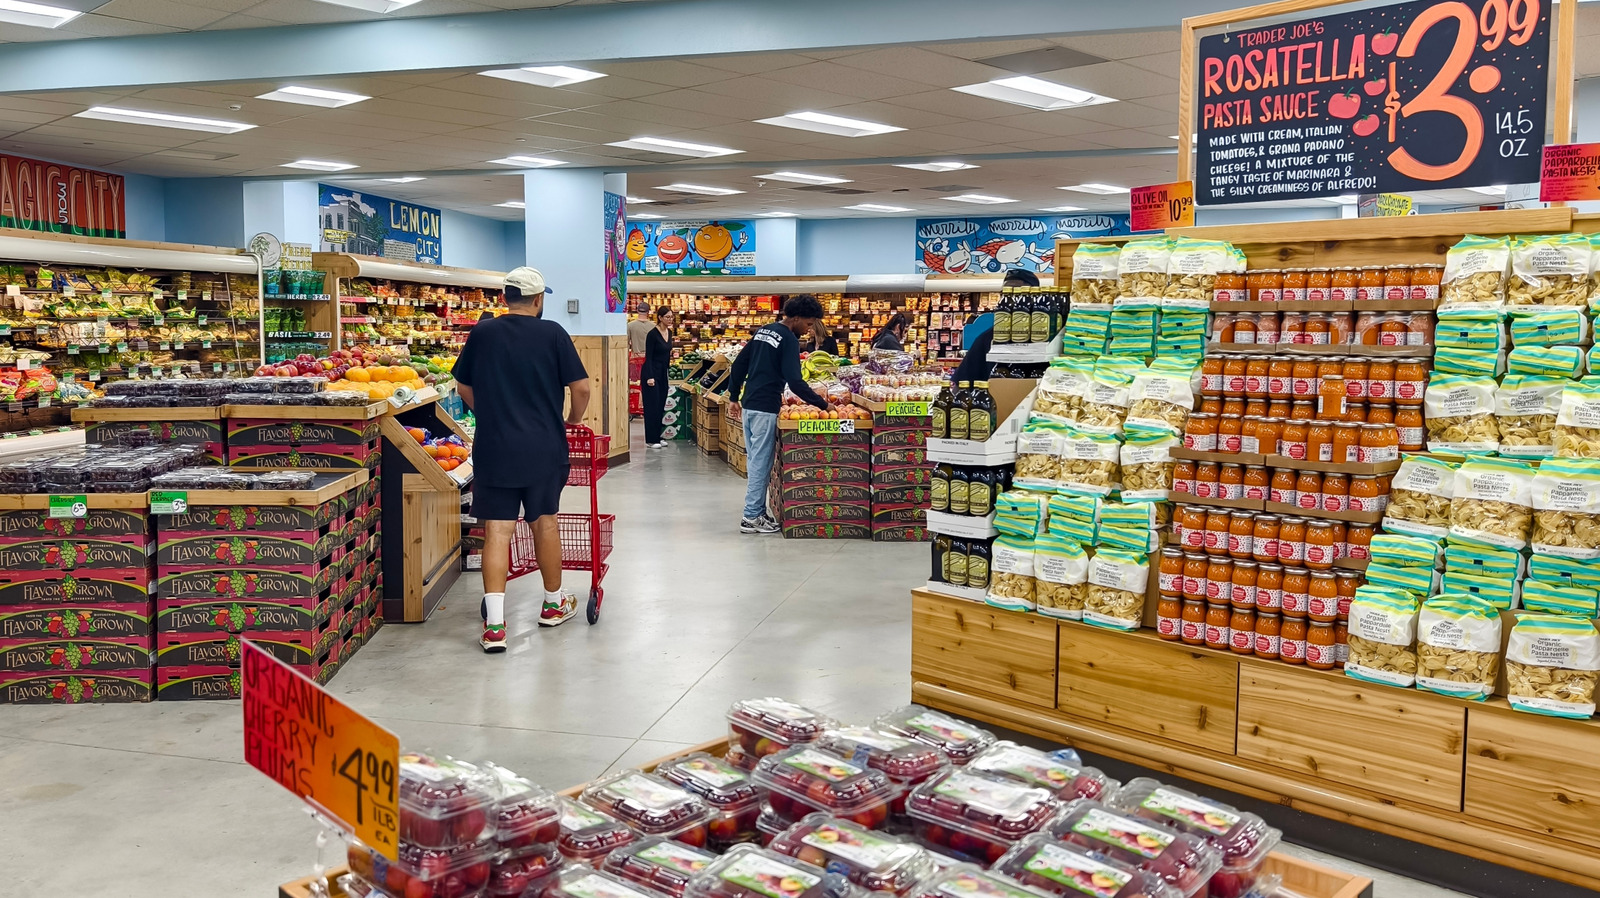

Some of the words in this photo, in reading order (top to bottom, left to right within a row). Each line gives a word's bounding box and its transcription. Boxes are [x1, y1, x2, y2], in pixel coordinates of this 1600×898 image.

[1237, 27, 1286, 49] TRADER
[1290, 22, 1325, 40] JOE'S
[1204, 33, 1366, 98] ROSATELLA
[1203, 99, 1252, 130] PASTA
[1259, 90, 1320, 123] SAUCE
[1495, 109, 1534, 135] 14.5
[1209, 134, 1237, 148] MADE
[1240, 131, 1265, 144] WITH
[1268, 128, 1304, 140] CREAM,
[1305, 125, 1343, 137] ITALIAN
[1268, 143, 1301, 155] GRANA
[1304, 139, 1345, 152] PADANO
[1499, 138, 1529, 158] OZ
[1545, 148, 1581, 158] ORGANIC
[1210, 162, 1250, 175] CHEESE!
[1255, 160, 1262, 170] A
[1266, 155, 1314, 170] MIXTURE
[1317, 153, 1331, 164] OF
[1335, 152, 1355, 163] THE
[1543, 168, 1568, 178] PASTA
[1570, 166, 1596, 176] NESTS
[1210, 174, 1240, 186] TANGY
[1242, 171, 1270, 183] TASTE
[1273, 171, 1284, 181] OF
[1286, 168, 1340, 181] MARINARA
[1344, 165, 1352, 177] &
[1210, 187, 1225, 198] THE
[1229, 184, 1255, 197] SILKY
[1257, 182, 1309, 195] CREAMINESS
[1311, 181, 1324, 191] OF
[1327, 175, 1377, 191] ALFREDO!
[57, 182, 68, 224] 305
[69, 168, 121, 239] CITY
[1131, 191, 1157, 205] OLIVE
[1157, 190, 1169, 203] OIL
[389, 202, 440, 239] LEMON
[919, 218, 980, 248] merrily
[989, 219, 1045, 241] merrily
[1056, 215, 1120, 236] merrily
[415, 238, 439, 258] CITY
[889, 406, 922, 415] PEACHES
[174, 426, 210, 440] GROWN
[258, 428, 290, 441] FLAVOR
[301, 428, 335, 440] GROWN
[882, 434, 905, 444] FLAVOR
[256, 458, 288, 468] FLAVOR
[299, 458, 331, 467] GROWN
[791, 452, 814, 461] FLAVOR
[840, 452, 863, 460] GROWN
[840, 471, 863, 479] GROWN
[882, 470, 904, 480] FLAVOR
[792, 489, 814, 498] FLAVOR
[840, 489, 863, 498] GROWN
[879, 491, 901, 501] FLAVOR
[1557, 485, 1582, 493] Organic
[171, 512, 210, 527] FLAVOR
[259, 511, 300, 526] GROWN
[792, 508, 814, 517] FLAVOR
[840, 508, 863, 516] GROWN
[891, 511, 912, 520] FLAVOR
[0, 515, 39, 533] FLAVOR
[88, 516, 131, 531] GROWN
[793, 528, 815, 537] FLAVOR
[840, 528, 864, 536] GROWN
[882, 530, 904, 540] FLAVOR
[1, 550, 40, 567] FLAVOR
[89, 549, 132, 565] GROWN
[171, 545, 211, 562] FLAVOR
[259, 545, 300, 560] GROWN
[24, 584, 61, 600] FLAVOR
[74, 584, 115, 599] GROWN
[172, 579, 211, 595] FLAVOR
[259, 578, 300, 594] GROWN
[3, 619, 43, 636] FLAVOR
[92, 618, 135, 632] GROWN
[171, 612, 210, 628] FLAVOR
[258, 611, 300, 626] GROWN
[1360, 623, 1374, 631] Pasta
[6, 651, 45, 668] FLAVOR
[94, 650, 137, 665] GROWN
[188, 646, 225, 661] FLAVOR
[8, 685, 47, 702] FLAVOR
[96, 684, 138, 699] GROWN
[192, 681, 228, 696] FLAVOR
[244, 648, 334, 739] ORGANIC
[244, 693, 318, 766] CHERRY
[247, 731, 314, 799] PLUMS
[373, 807, 396, 832] 1LB
